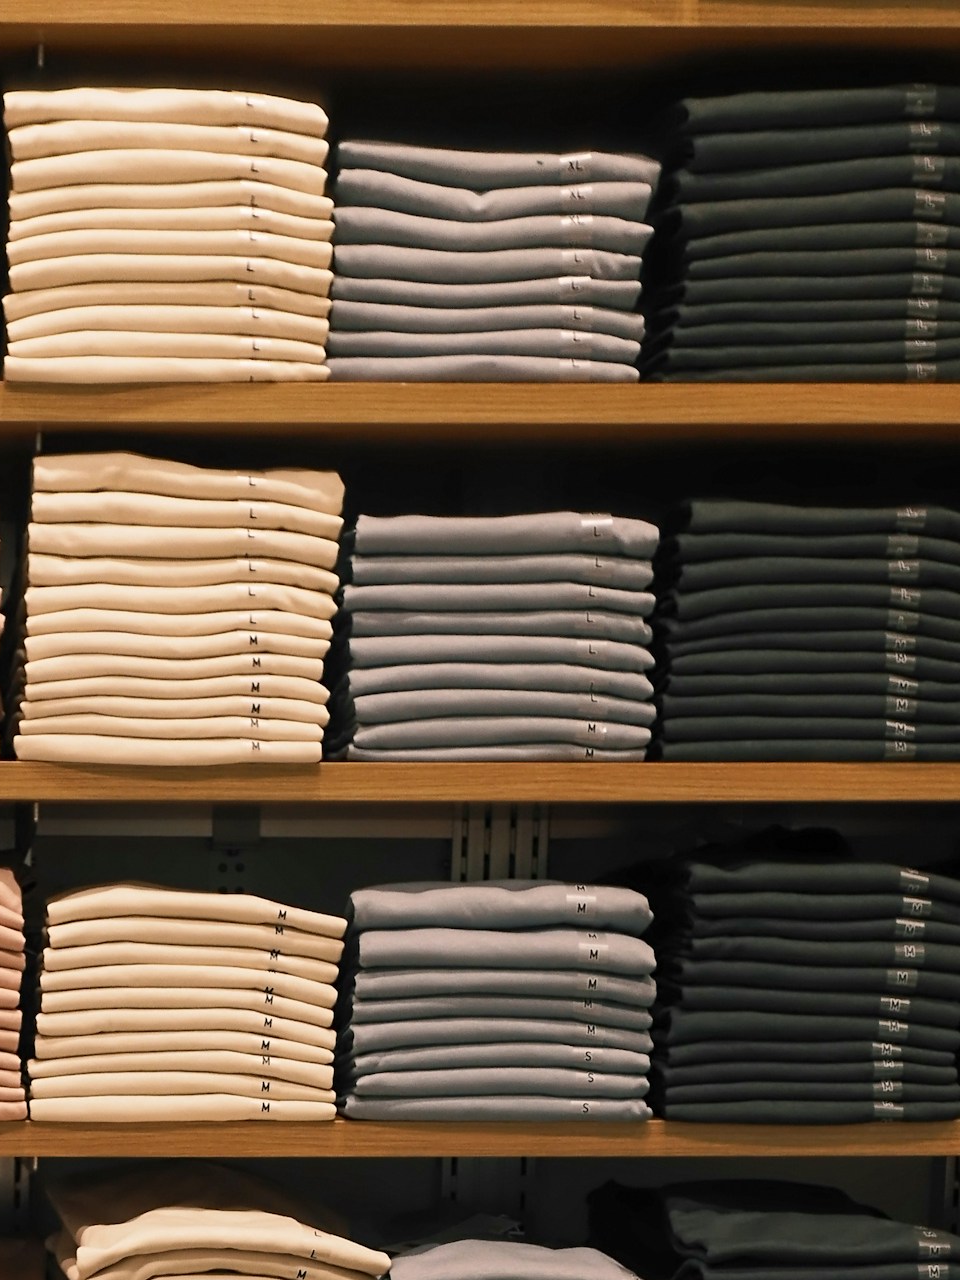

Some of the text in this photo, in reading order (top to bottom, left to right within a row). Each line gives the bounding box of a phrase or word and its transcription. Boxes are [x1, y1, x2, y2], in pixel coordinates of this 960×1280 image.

[250, 635, 257, 645] M
[253, 658, 260, 667] M
[251, 682, 260, 692] M
[251, 703, 260, 714] M
[588, 723, 596, 733] M
[577, 903, 586, 913] M
[278, 910, 286, 920] M
[590, 950, 598, 959] M
[588, 979, 597, 989] M
[265, 995, 273, 1005] M
[264, 1018, 272, 1027] M
[261, 1040, 270, 1050] M
[585, 1051, 592, 1061] S
[588, 1073, 594, 1083] S
[262, 1082, 270, 1091] M
[262, 1103, 270, 1112] M
[583, 1103, 589, 1113] S
[297, 1270, 307, 1280] M
[929, 1265, 940, 1278] M
